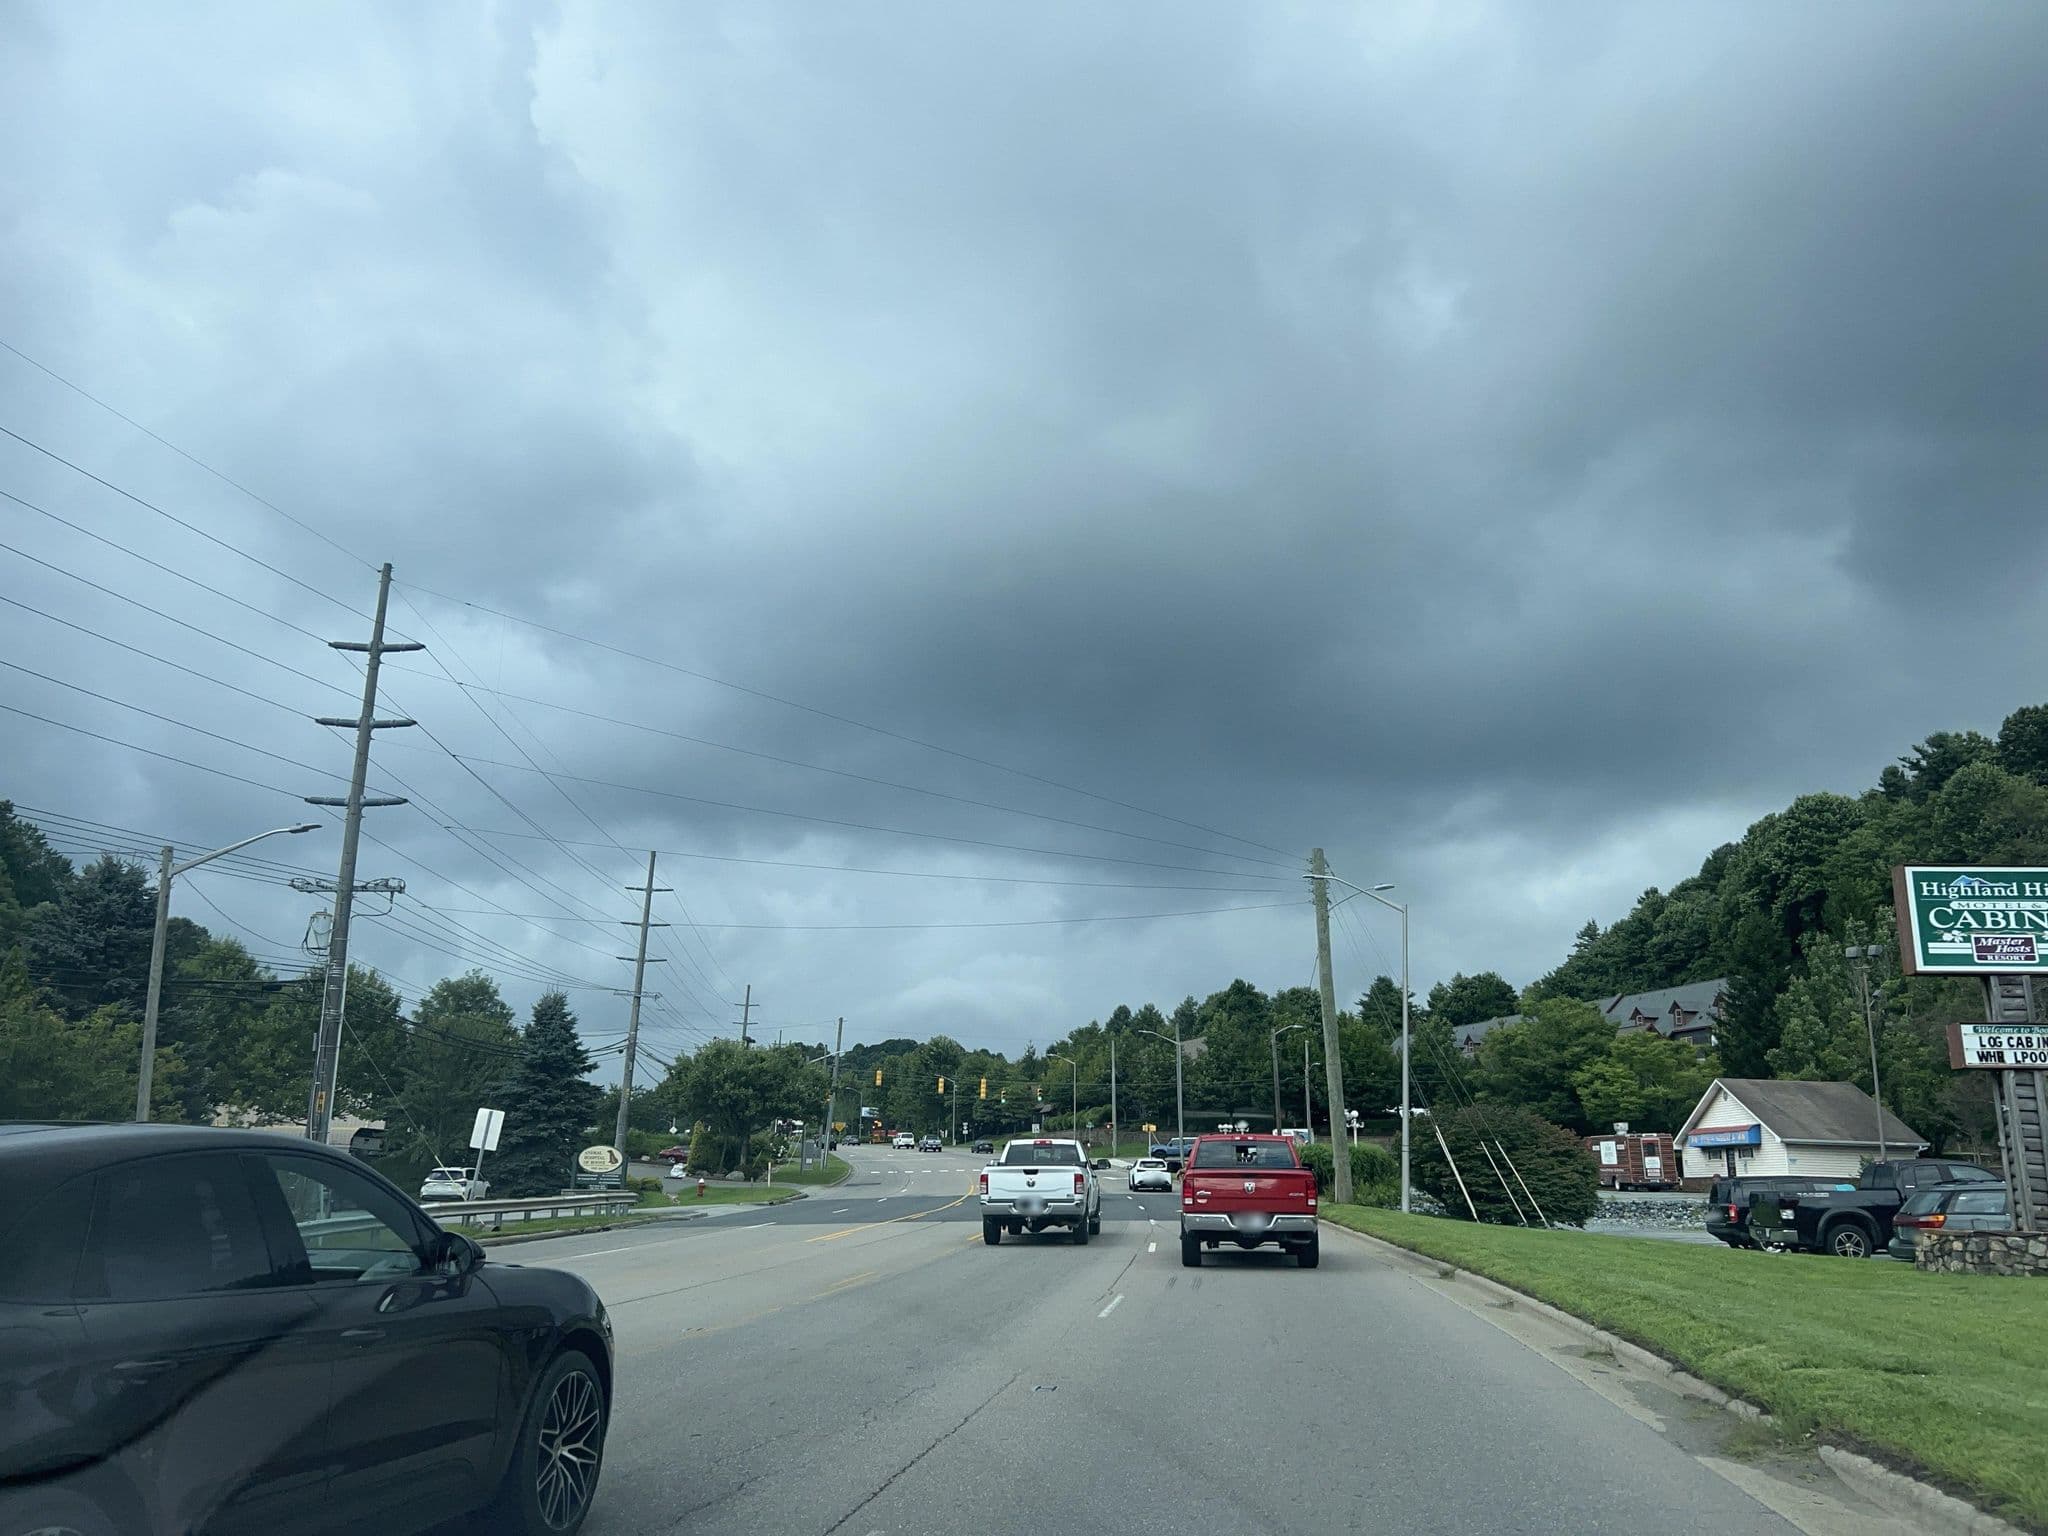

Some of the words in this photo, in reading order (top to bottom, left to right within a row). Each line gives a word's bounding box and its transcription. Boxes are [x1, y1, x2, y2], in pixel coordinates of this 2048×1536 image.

[1920, 882, 2019, 899] Highland
[1929, 907, 2048, 929] CABIN
[1977, 937, 2025, 946] Master
[1996, 945, 2032, 953] Hosts
[1975, 1026, 2020, 1034] Welcome
[2021, 1026, 2032, 1034] to
[1979, 1036, 2003, 1048] LOG
